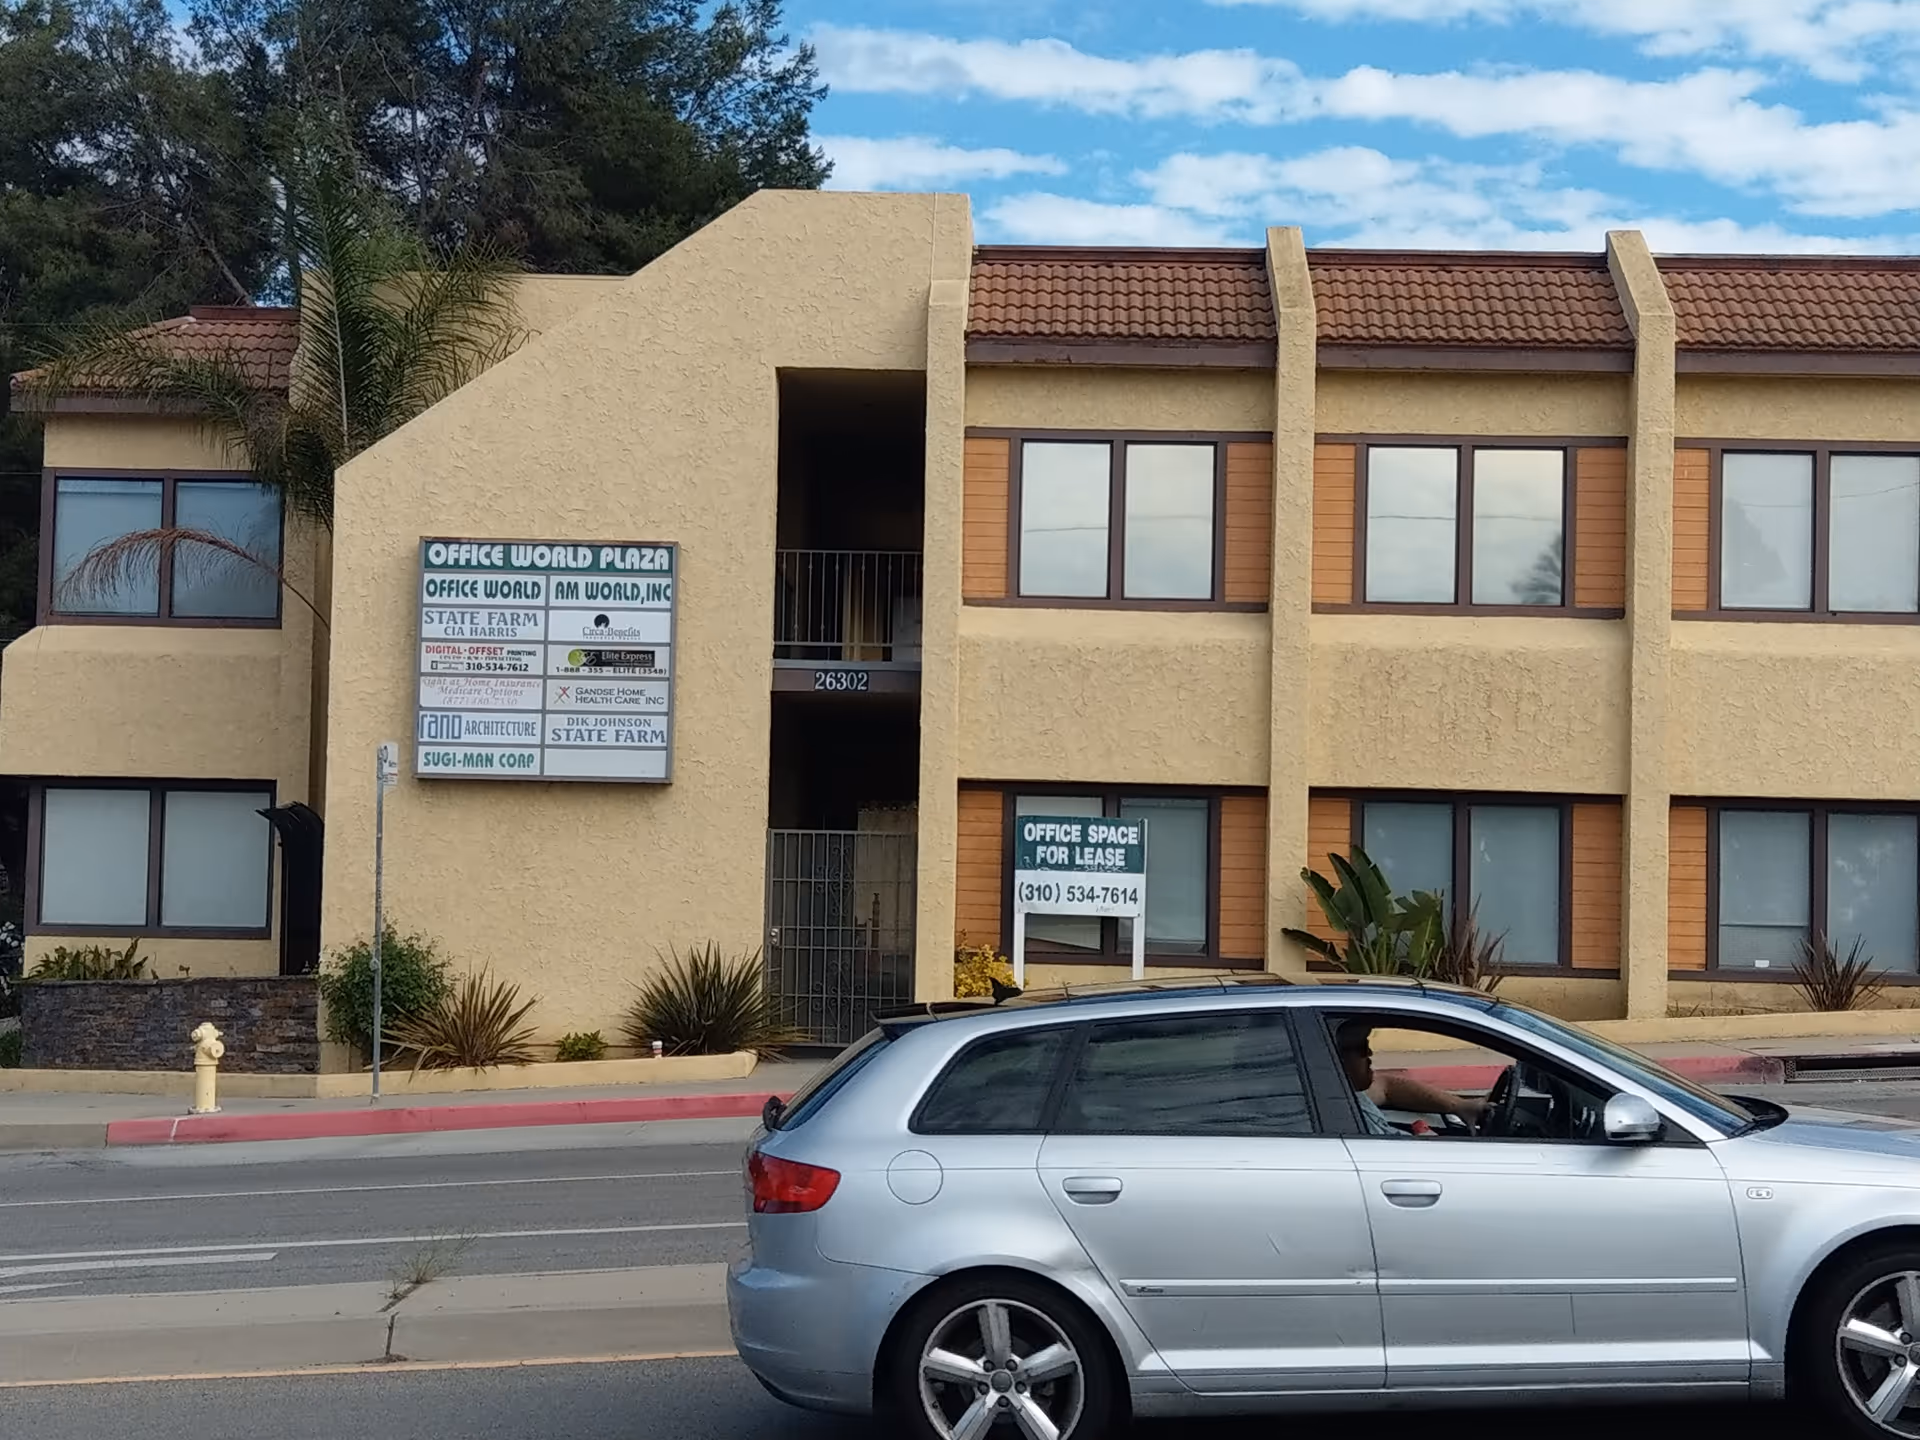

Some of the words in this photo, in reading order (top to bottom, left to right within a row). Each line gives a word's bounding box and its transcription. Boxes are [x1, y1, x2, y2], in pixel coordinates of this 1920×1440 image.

[428, 543, 504, 566] OFFICE
[510, 545, 593, 568] WORLD
[600, 547, 669, 570] PLAZA
[425, 578, 478, 598] OFFICE
[484, 580, 542, 600] WORLD
[555, 581, 579, 600] AM
[424, 611, 480, 625] STATE
[488, 612, 538, 626] FARM
[444, 626, 465, 636] CIA
[469, 627, 518, 637] HARRIS
[426, 646, 462, 654] DIGITAL
[468, 646, 504, 656] OFFSET
[602, 652, 620, 660] Elite
[621, 652, 652, 662] Express
[466, 662, 528, 672] 310-534-7612
[462, 678, 492, 686] Home
[815, 672, 868, 690] 26302
[438, 686, 482, 695] Medicare
[484, 688, 524, 698] Options
[646, 697, 664, 705] INC
[464, 720, 536, 736] ARCHITECTURE
[567, 717, 590, 726] DIK
[592, 718, 652, 728] JOHNSON
[552, 728, 608, 742] STATE
[615, 730, 666, 743] FARM
[424, 752, 494, 768] SUGI-MAN
[499, 753, 535, 768] CORP
[1024, 822, 1082, 842] OFFICE
[1088, 825, 1138, 844] SPACE
[1036, 846, 1069, 865] FOR
[1075, 846, 1126, 866] LEASE
[1018, 882, 1061, 904] (310)
[1067, 886, 1138, 904] 534-7614
